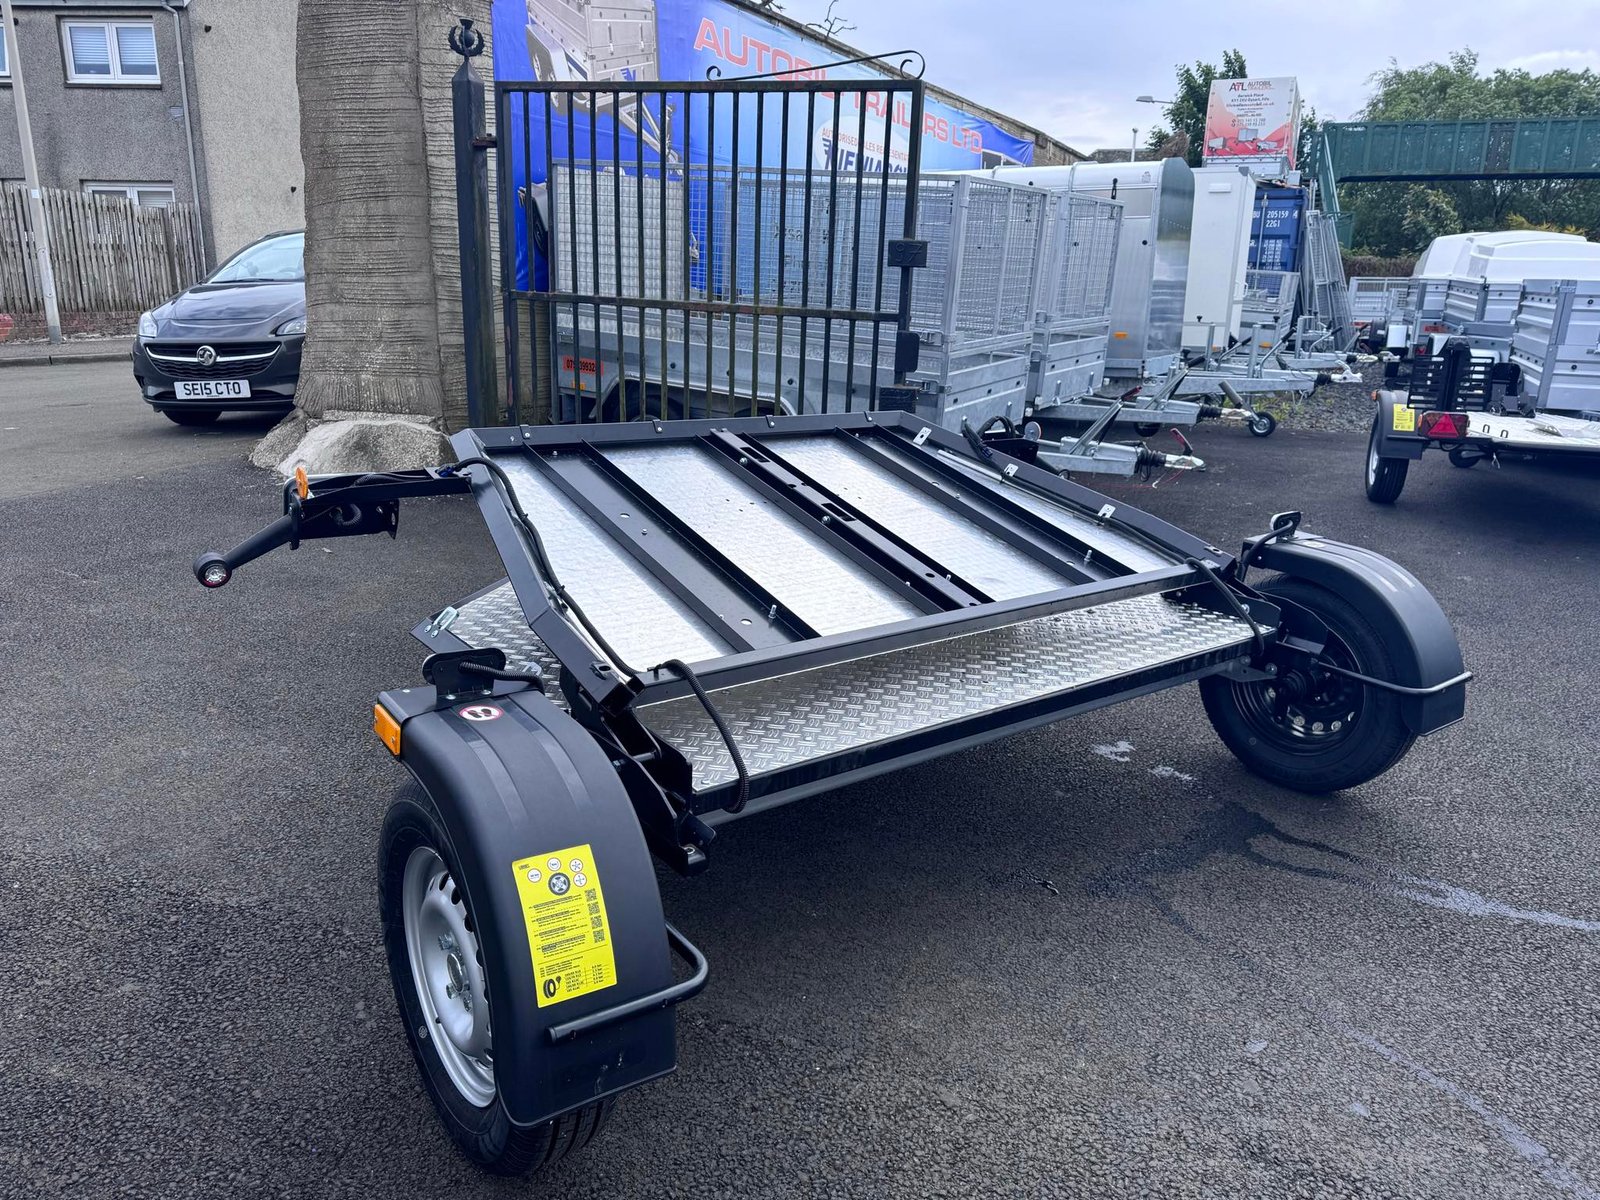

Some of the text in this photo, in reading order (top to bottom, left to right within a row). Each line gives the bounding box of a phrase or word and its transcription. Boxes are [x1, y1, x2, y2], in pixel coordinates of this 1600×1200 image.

[951, 124, 983, 154] LTD
[1266, 210, 1289, 219] 205159
[183, 381, 241, 396] SE15 CTO
